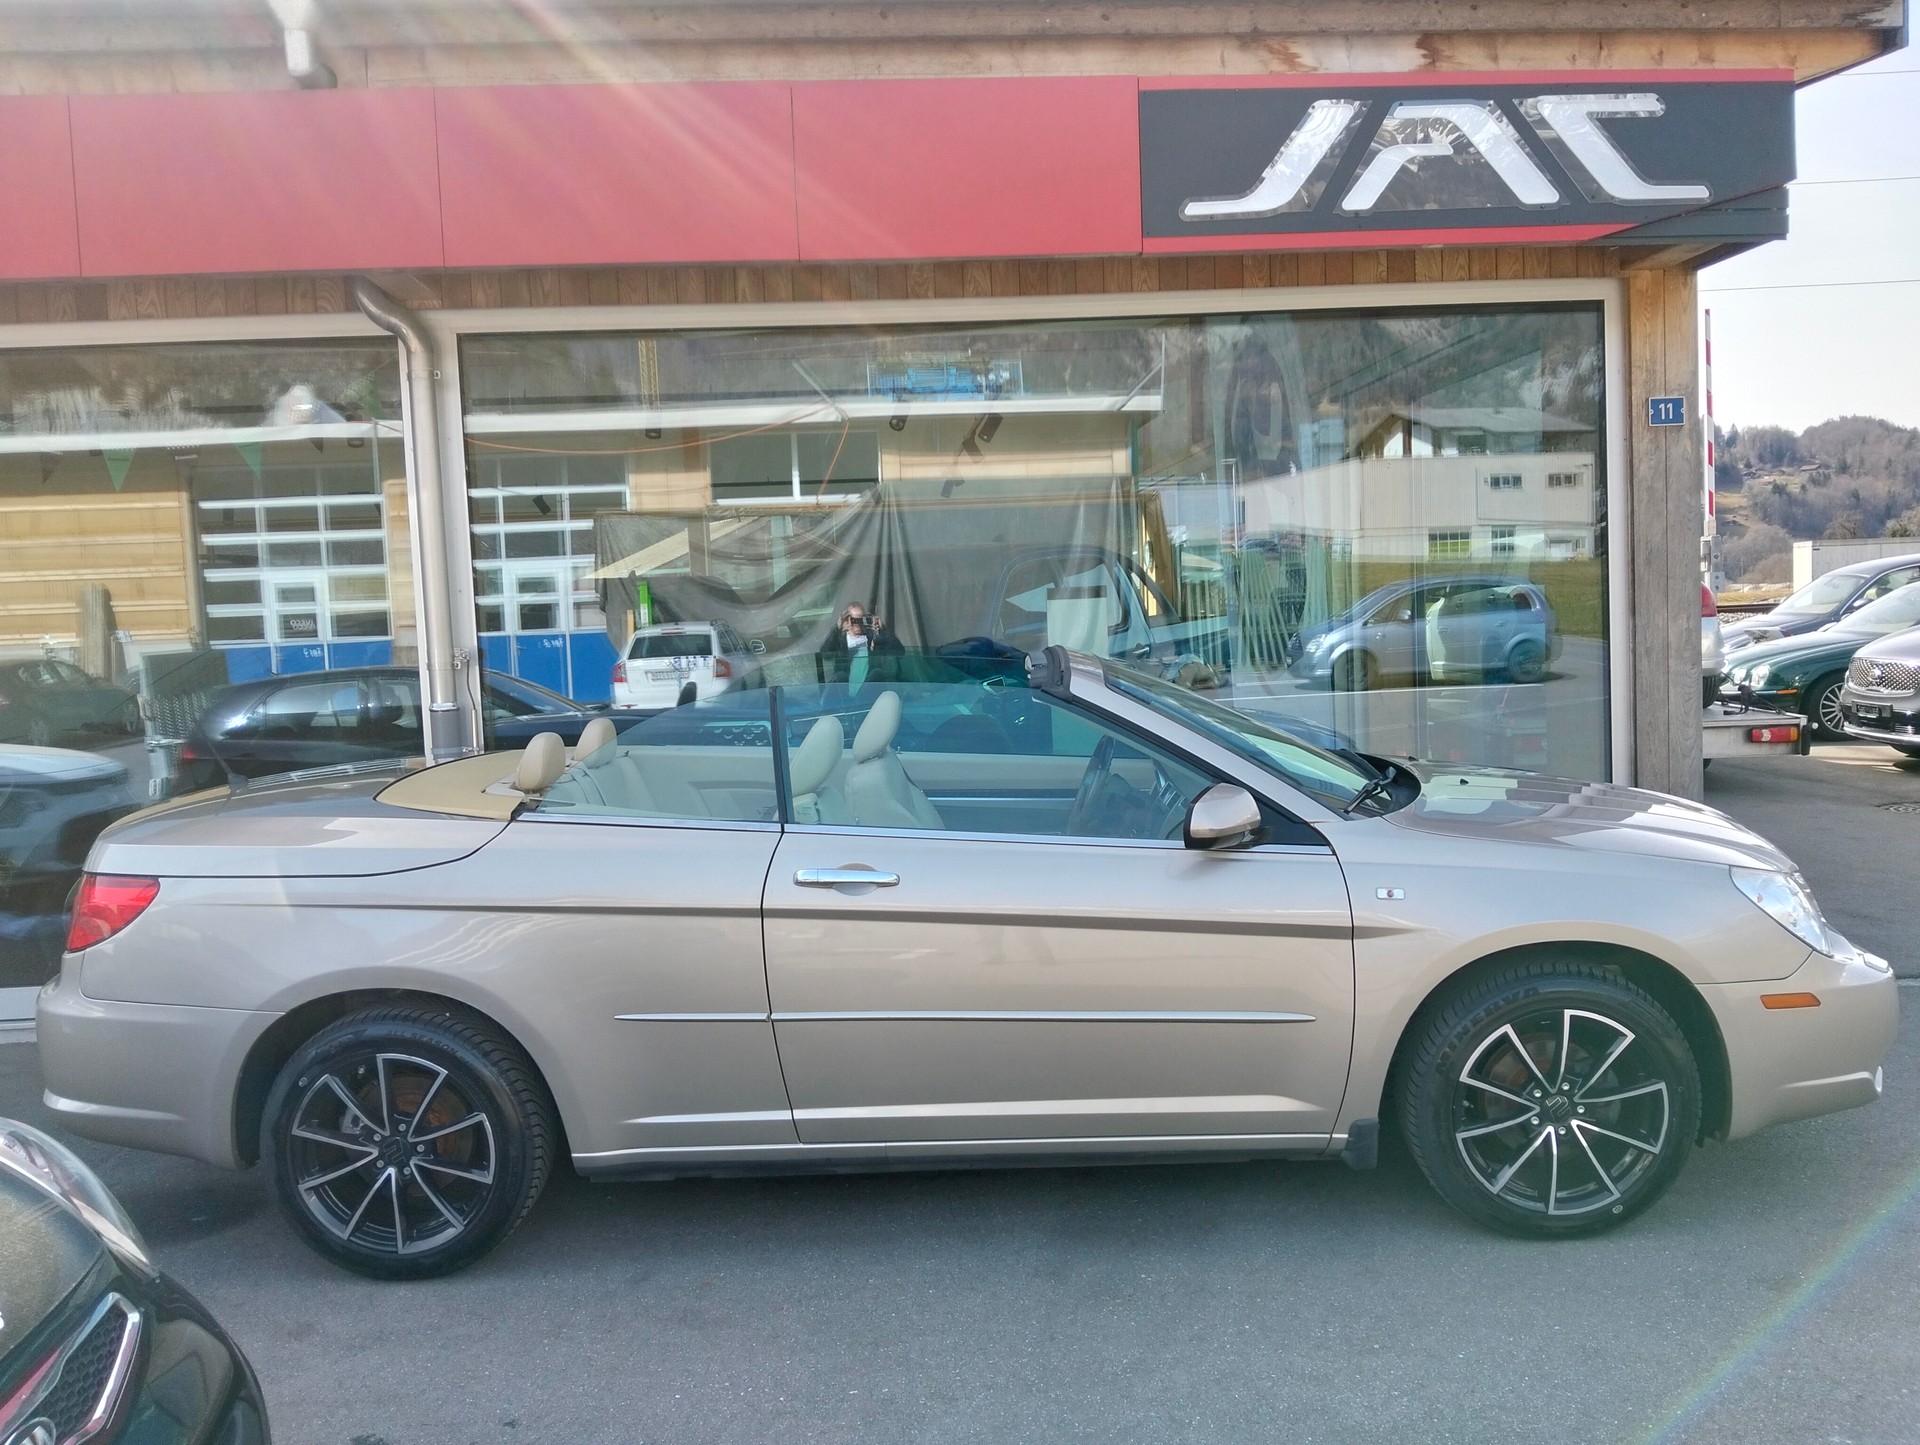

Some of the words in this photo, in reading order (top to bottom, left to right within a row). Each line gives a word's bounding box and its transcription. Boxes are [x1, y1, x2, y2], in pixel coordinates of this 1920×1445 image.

[1183, 96, 1711, 216] JAC
[1658, 402, 1674, 420] 11
[386, 1029, 405, 1039] ALL
[411, 1031, 458, 1054] SEASON
[1434, 986, 1541, 1075] MINERVA
